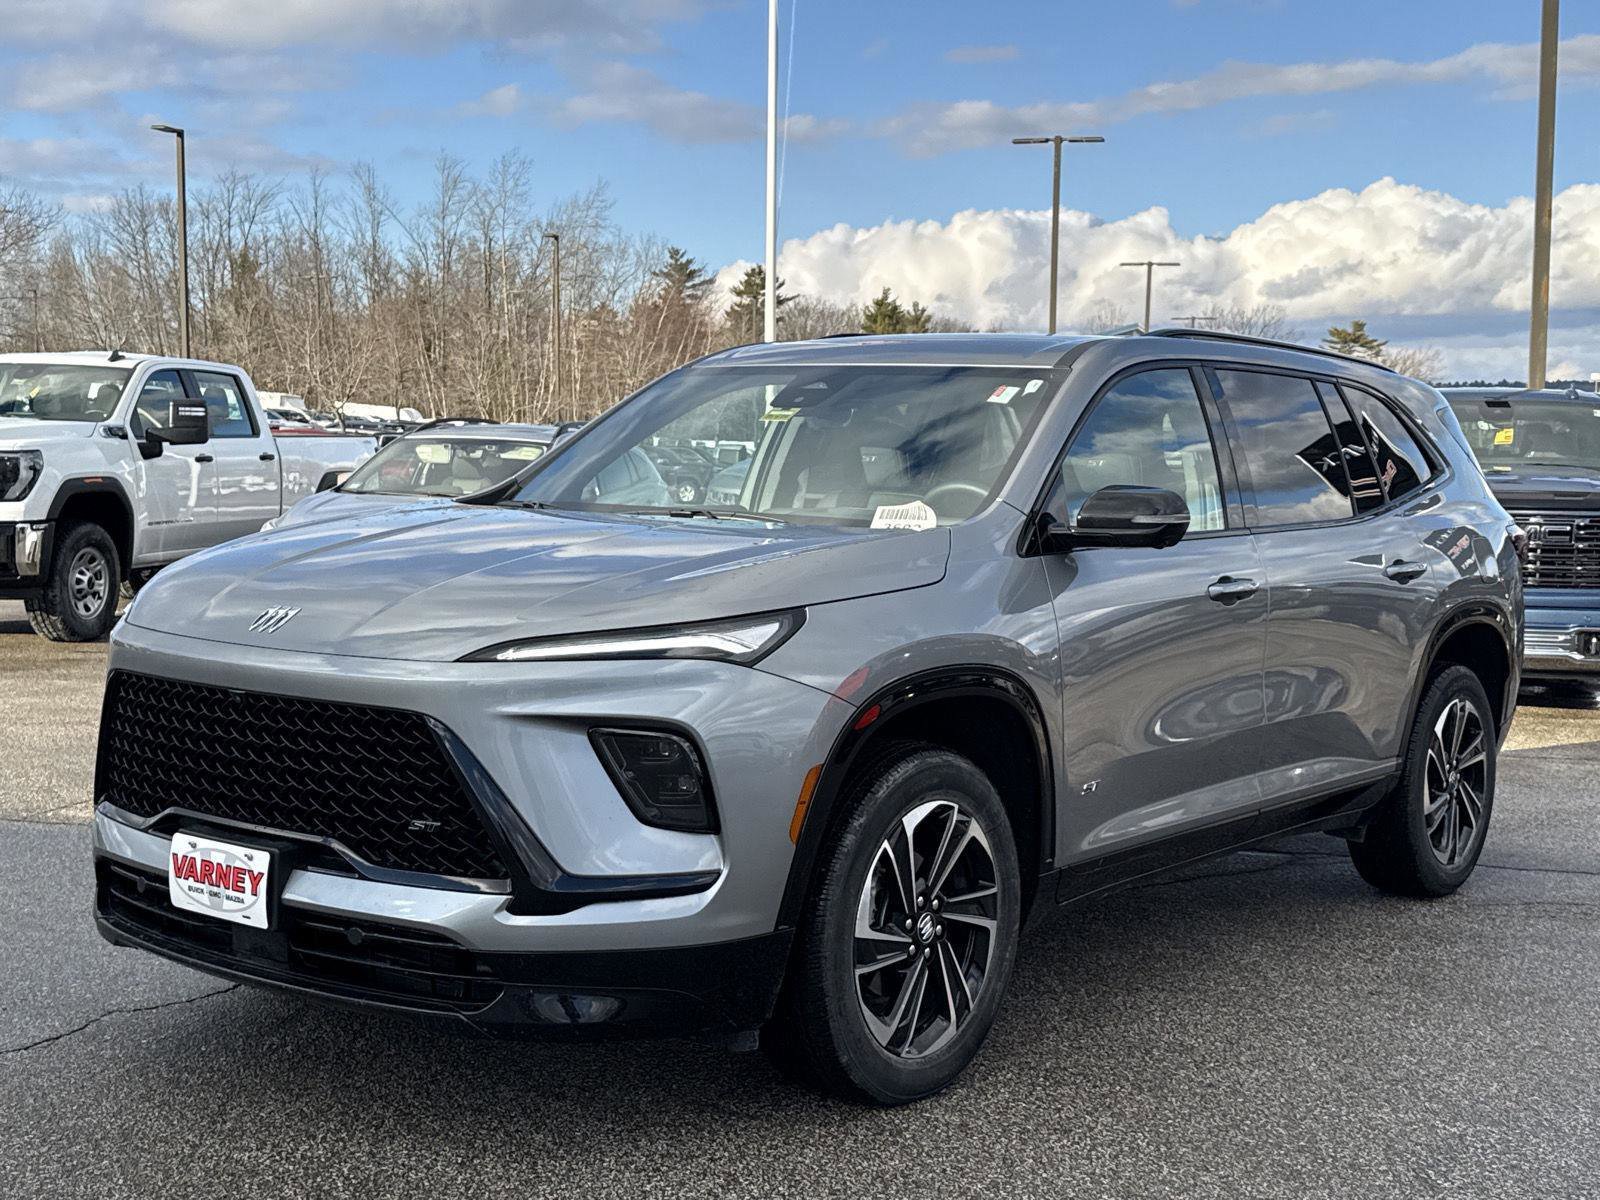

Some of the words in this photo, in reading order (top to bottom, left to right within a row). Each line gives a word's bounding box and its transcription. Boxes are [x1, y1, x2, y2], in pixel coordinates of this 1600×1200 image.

[408, 820, 441, 832] ST
[172, 852, 264, 897] VARNEY
[188, 885, 205, 895] BUICK
[208, 889, 222, 899] GMC
[225, 893, 245, 904] MAZDA
